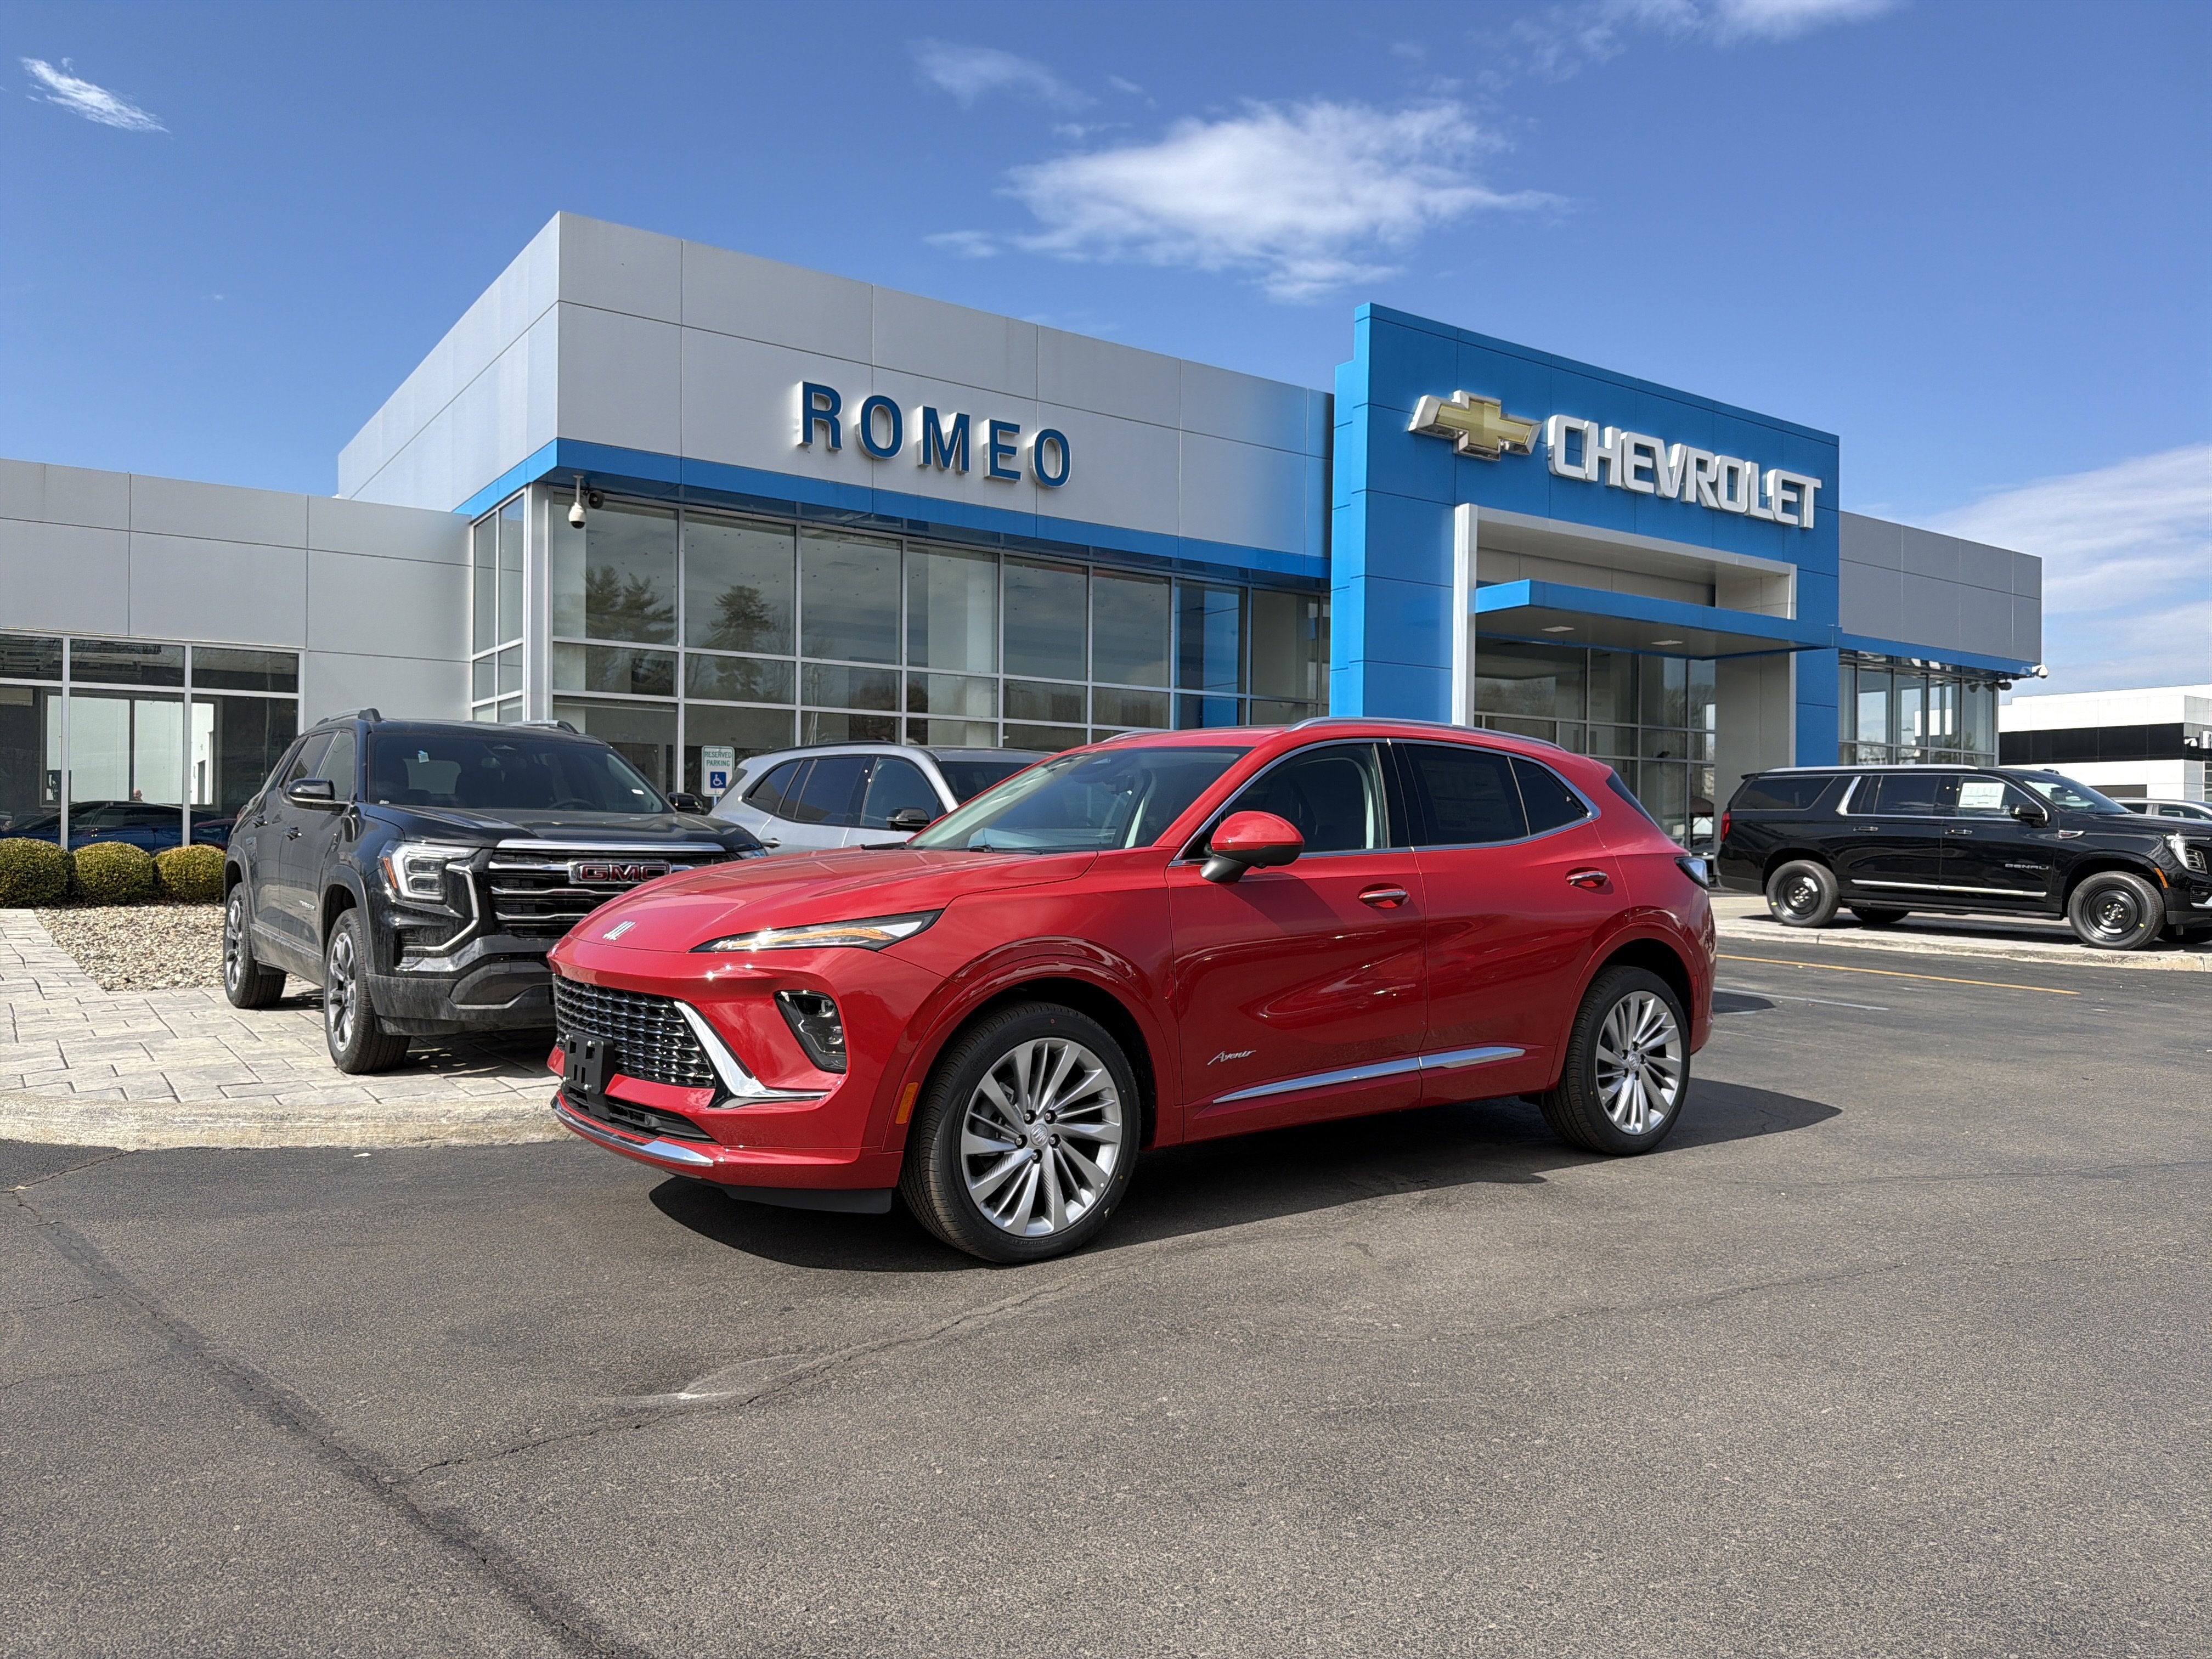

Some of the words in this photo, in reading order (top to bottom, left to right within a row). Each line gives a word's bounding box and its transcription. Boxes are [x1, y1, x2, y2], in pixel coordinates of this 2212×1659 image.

[798, 381, 1072, 488] ROMEO
[1547, 414, 1822, 529] CHEVROLET
[579, 864, 667, 882] GMC
[1207, 1049, 1257, 1065] Avenir
